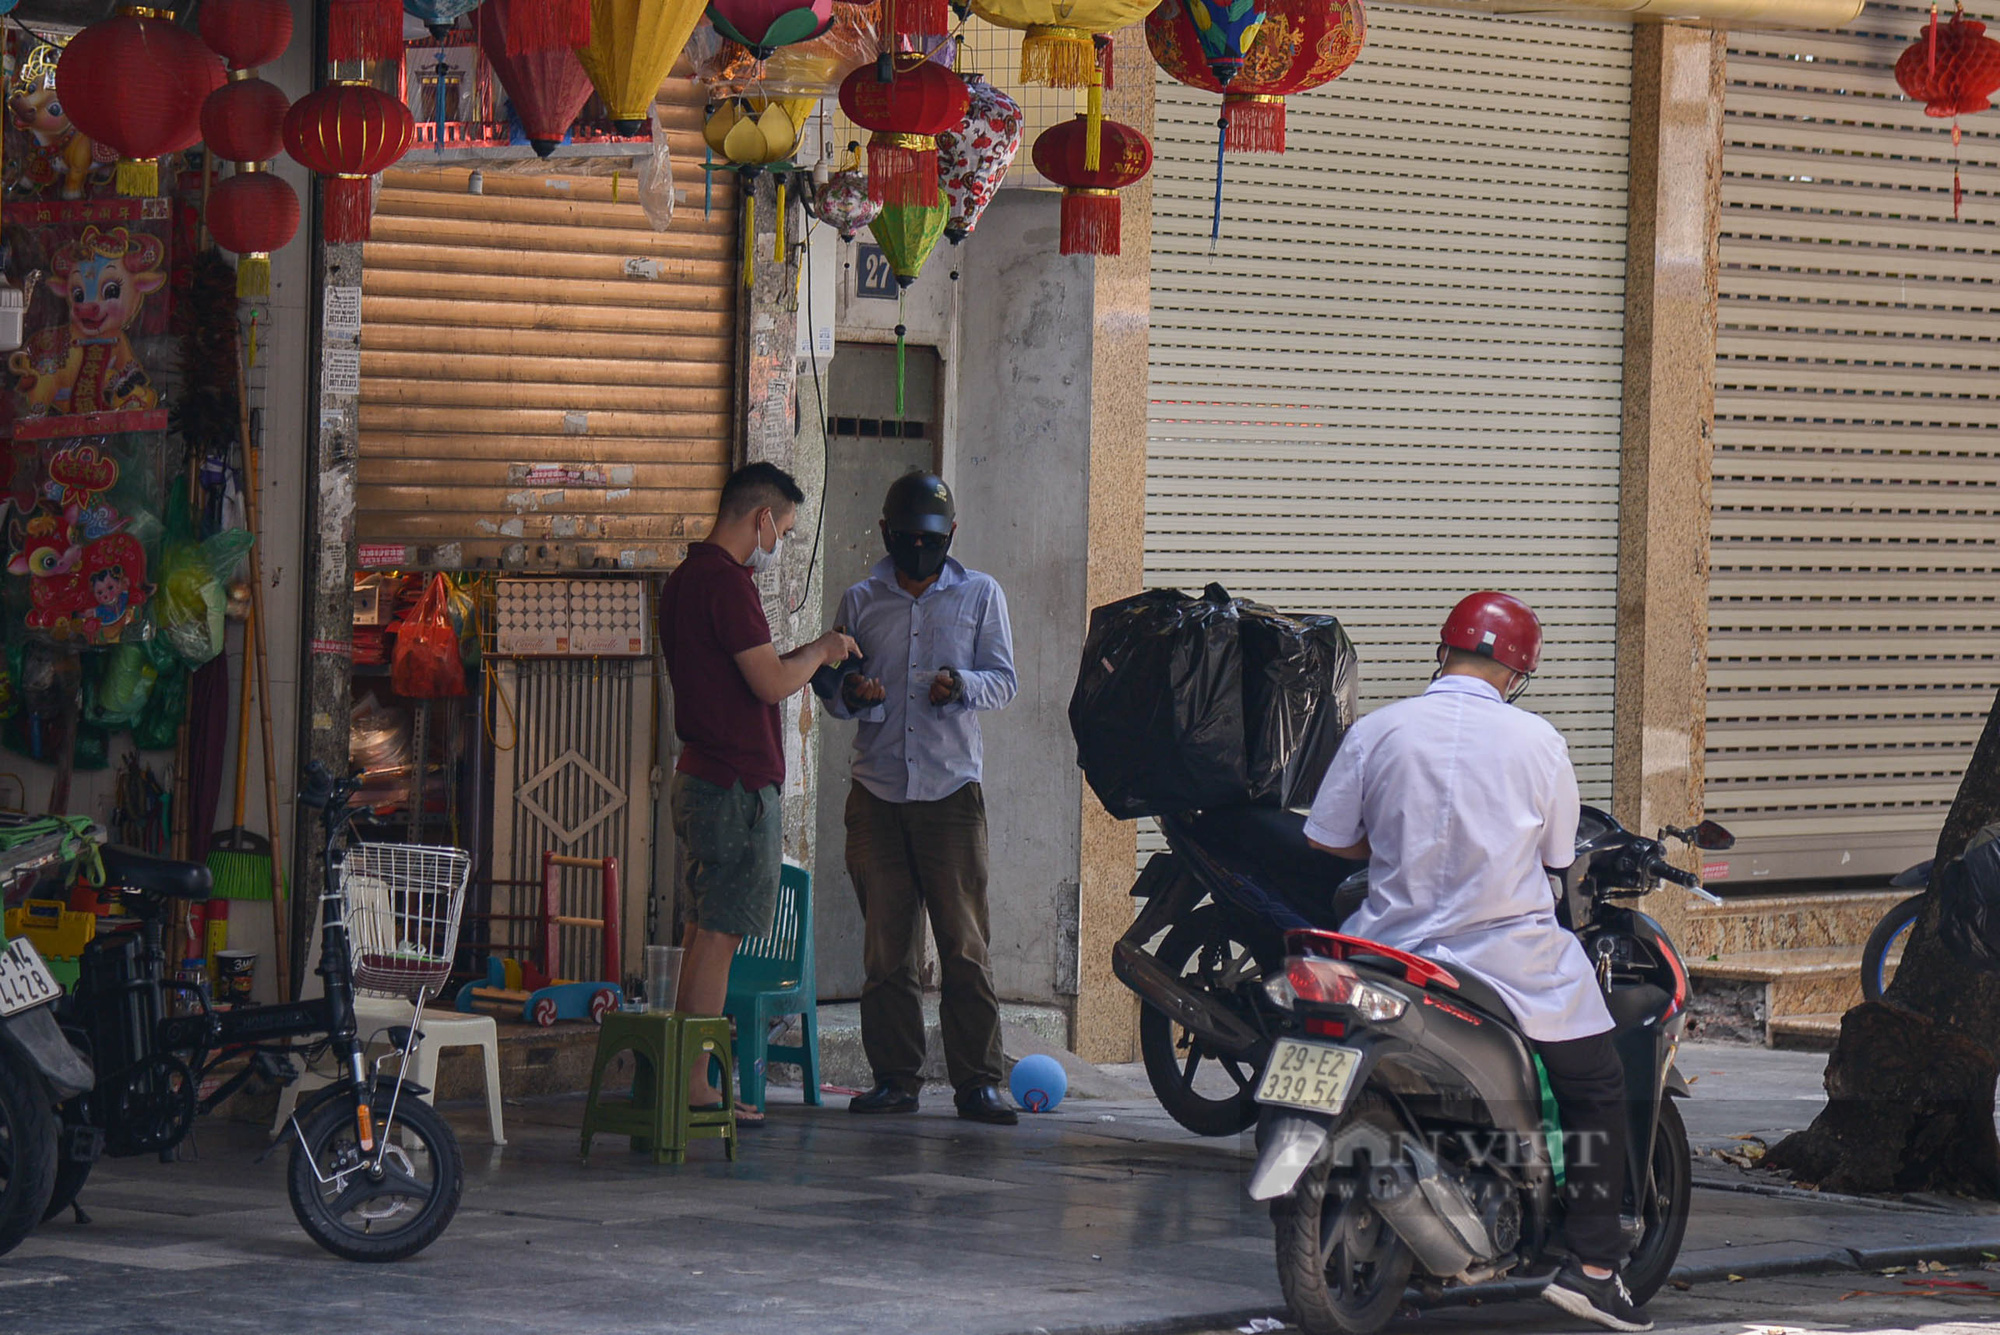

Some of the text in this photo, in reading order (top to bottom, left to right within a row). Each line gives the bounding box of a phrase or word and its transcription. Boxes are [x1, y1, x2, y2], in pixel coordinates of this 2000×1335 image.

[865, 253, 891, 289] 27
[1280, 1044, 1346, 1078] 29-E2
[1263, 1073, 1340, 1109] 339.54
